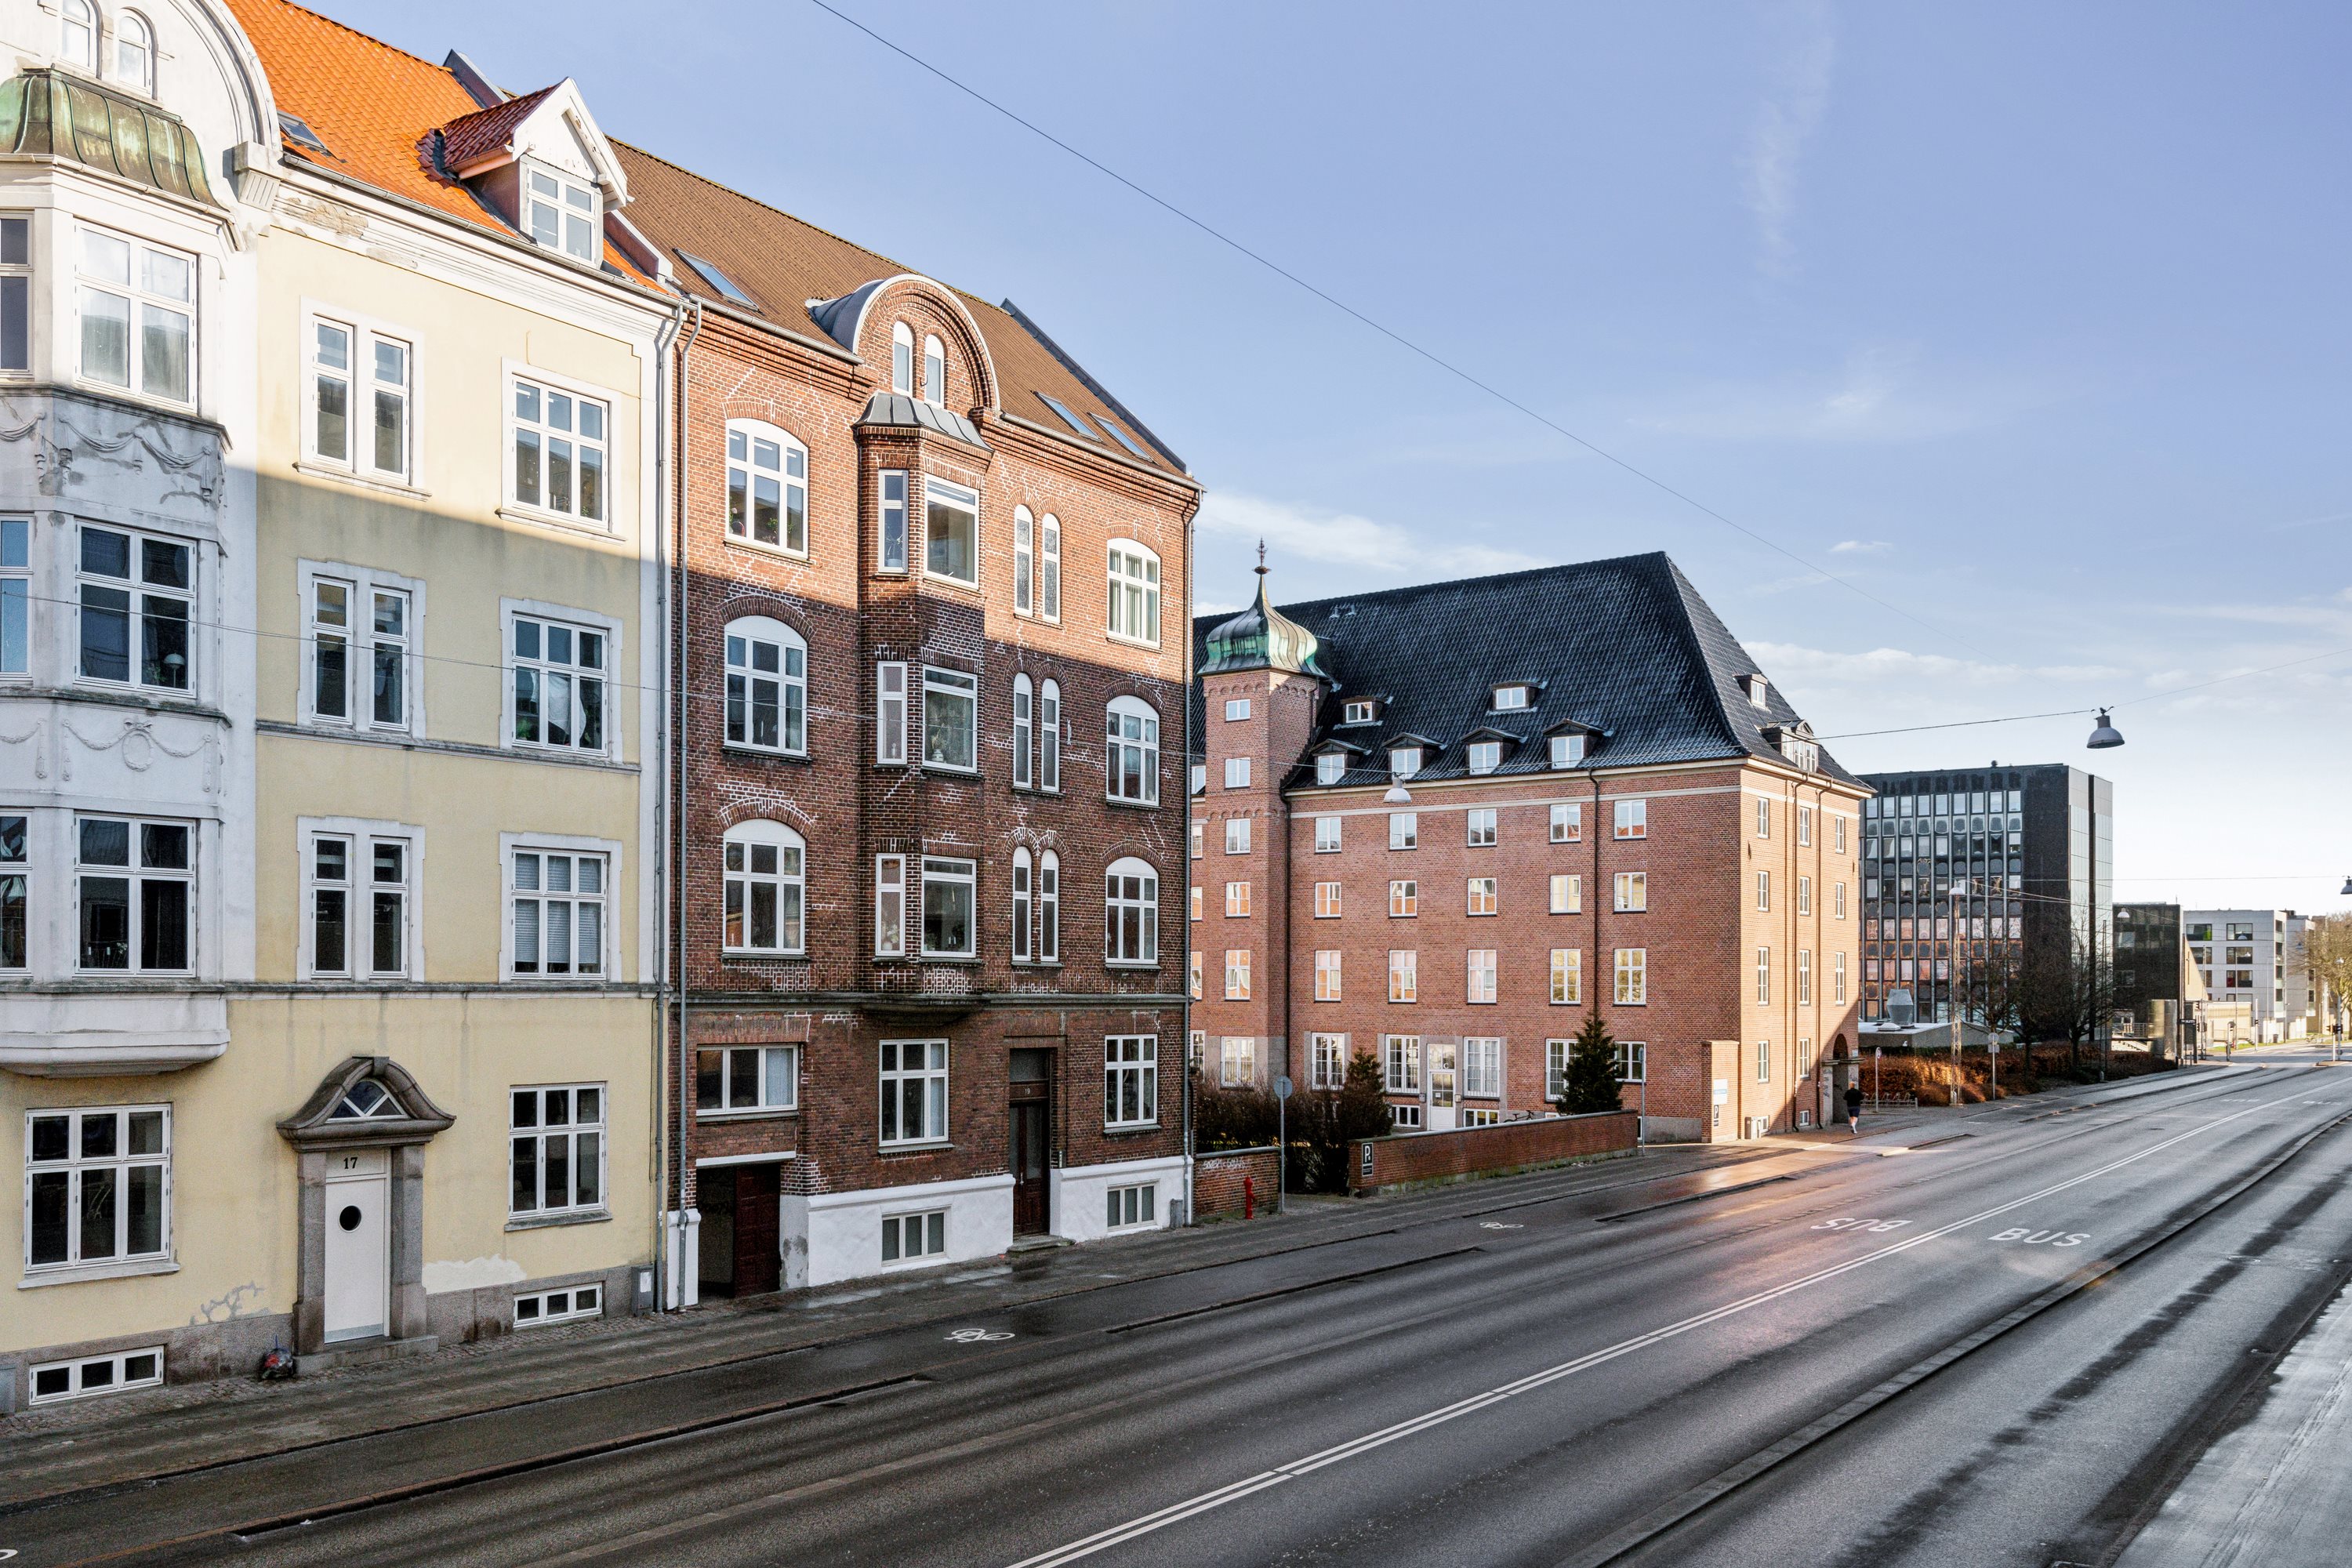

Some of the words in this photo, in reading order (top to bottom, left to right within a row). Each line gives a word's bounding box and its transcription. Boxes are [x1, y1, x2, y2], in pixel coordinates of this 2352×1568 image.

[343, 1156, 358, 1169] 17
[1810, 1218, 1913, 1232] BUS
[1987, 1228, 2091, 1247] BUS
